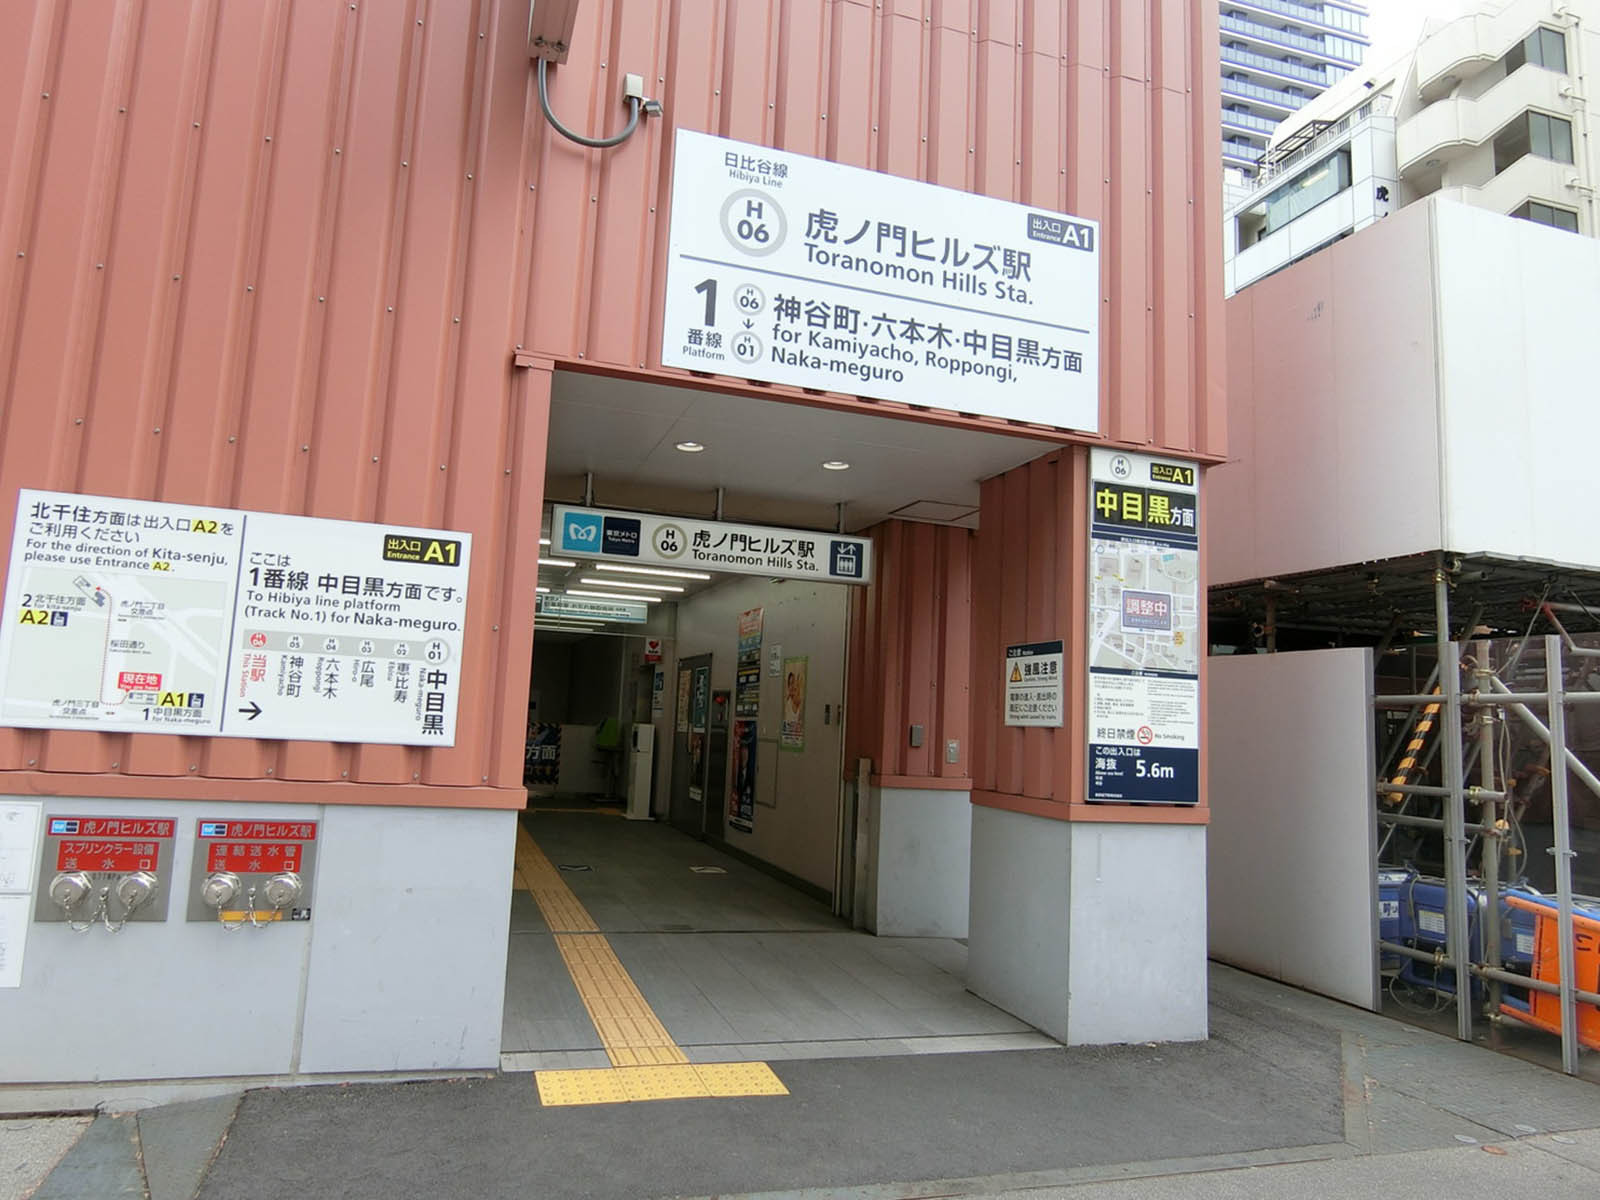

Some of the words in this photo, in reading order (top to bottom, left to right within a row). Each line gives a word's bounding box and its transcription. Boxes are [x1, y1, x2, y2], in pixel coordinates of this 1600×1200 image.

[725, 151, 788, 178] 日比谷線
[729, 169, 760, 184] Hibiya
[763, 174, 783, 188] Line
[746, 200, 763, 219] H
[737, 220, 769, 243] 06
[1033, 217, 1061, 233] 出入口
[805, 208, 1031, 282] 虎ノ門ヒルズ駅
[1032, 230, 1061, 242] Entrance
[1062, 224, 1090, 248] A1
[804, 242, 934, 285] Toranomon
[943, 270, 987, 296] Hills
[995, 281, 1033, 305] Sta.
[746, 288, 753, 297] H
[694, 278, 717, 327] 1
[739, 296, 759, 310] 06
[688, 328, 722, 349] 番線
[682, 345, 725, 361] Platform
[737, 344, 754, 357] 01
[772, 323, 802, 344] for
[809, 331, 919, 366] Kamiyacho,
[925, 351, 1017, 383] Roppongi,
[772, 346, 904, 382] Naka-meguro
[1115, 467, 1126, 475] 06
[1172, 468, 1192, 484] A1
[29, 522, 140, 544] ご利用ください
[666, 529, 675, 539] H
[26, 539, 46, 549] For
[51, 541, 72, 551] the
[75, 543, 131, 557] direction
[135, 547, 149, 558] of
[152, 548, 228, 567] Kita-senju,
[388, 538, 421, 552] 出入口
[423, 540, 456, 564] A1
[661, 540, 678, 552] 06
[692, 529, 815, 558] 虎ノ門ヒルズ駅
[24, 551, 66, 562] please
[70, 556, 91, 565] use
[95, 557, 150, 570] Entrance
[249, 552, 291, 567] ここは
[387, 551, 420, 560] Entrance
[692, 548, 763, 566] Toranomon
[767, 556, 793, 569] Hills
[797, 560, 819, 572] Sta.
[249, 567, 309, 591] 1番線
[22, 594, 32, 607] 2
[247, 590, 263, 601] To
[268, 591, 311, 606] Hibiya
[315, 593, 339, 607] line
[344, 597, 400, 612] platform
[20, 609, 49, 625] A2
[244, 605, 286, 619] (Track
[291, 607, 326, 623] No.1)
[331, 612, 350, 624] for
[354, 612, 460, 633] Naka-meguro.
[428, 651, 441, 660] 01
[432, 642, 440, 650] H
[250, 654, 267, 682] 当駅
[287, 655, 304, 698] 神谷町
[360, 660, 376, 687] 広尾
[123, 673, 158, 684] 現在地
[322, 658, 340, 699] 六本木
[394, 662, 410, 703] 恵比寿
[161, 692, 184, 707] A1
[422, 669, 447, 735] 中目黒
[142, 708, 149, 720] 1
[1096, 747, 1140, 756] この出入口は
[1136, 759, 1174, 778] 5.6m
[83, 821, 170, 835] 虎ノ門ヒルズ駅
[231, 824, 312, 837] 虎ノ門ヒルズ駅
[64, 843, 154, 855] スプリンクラー設備
